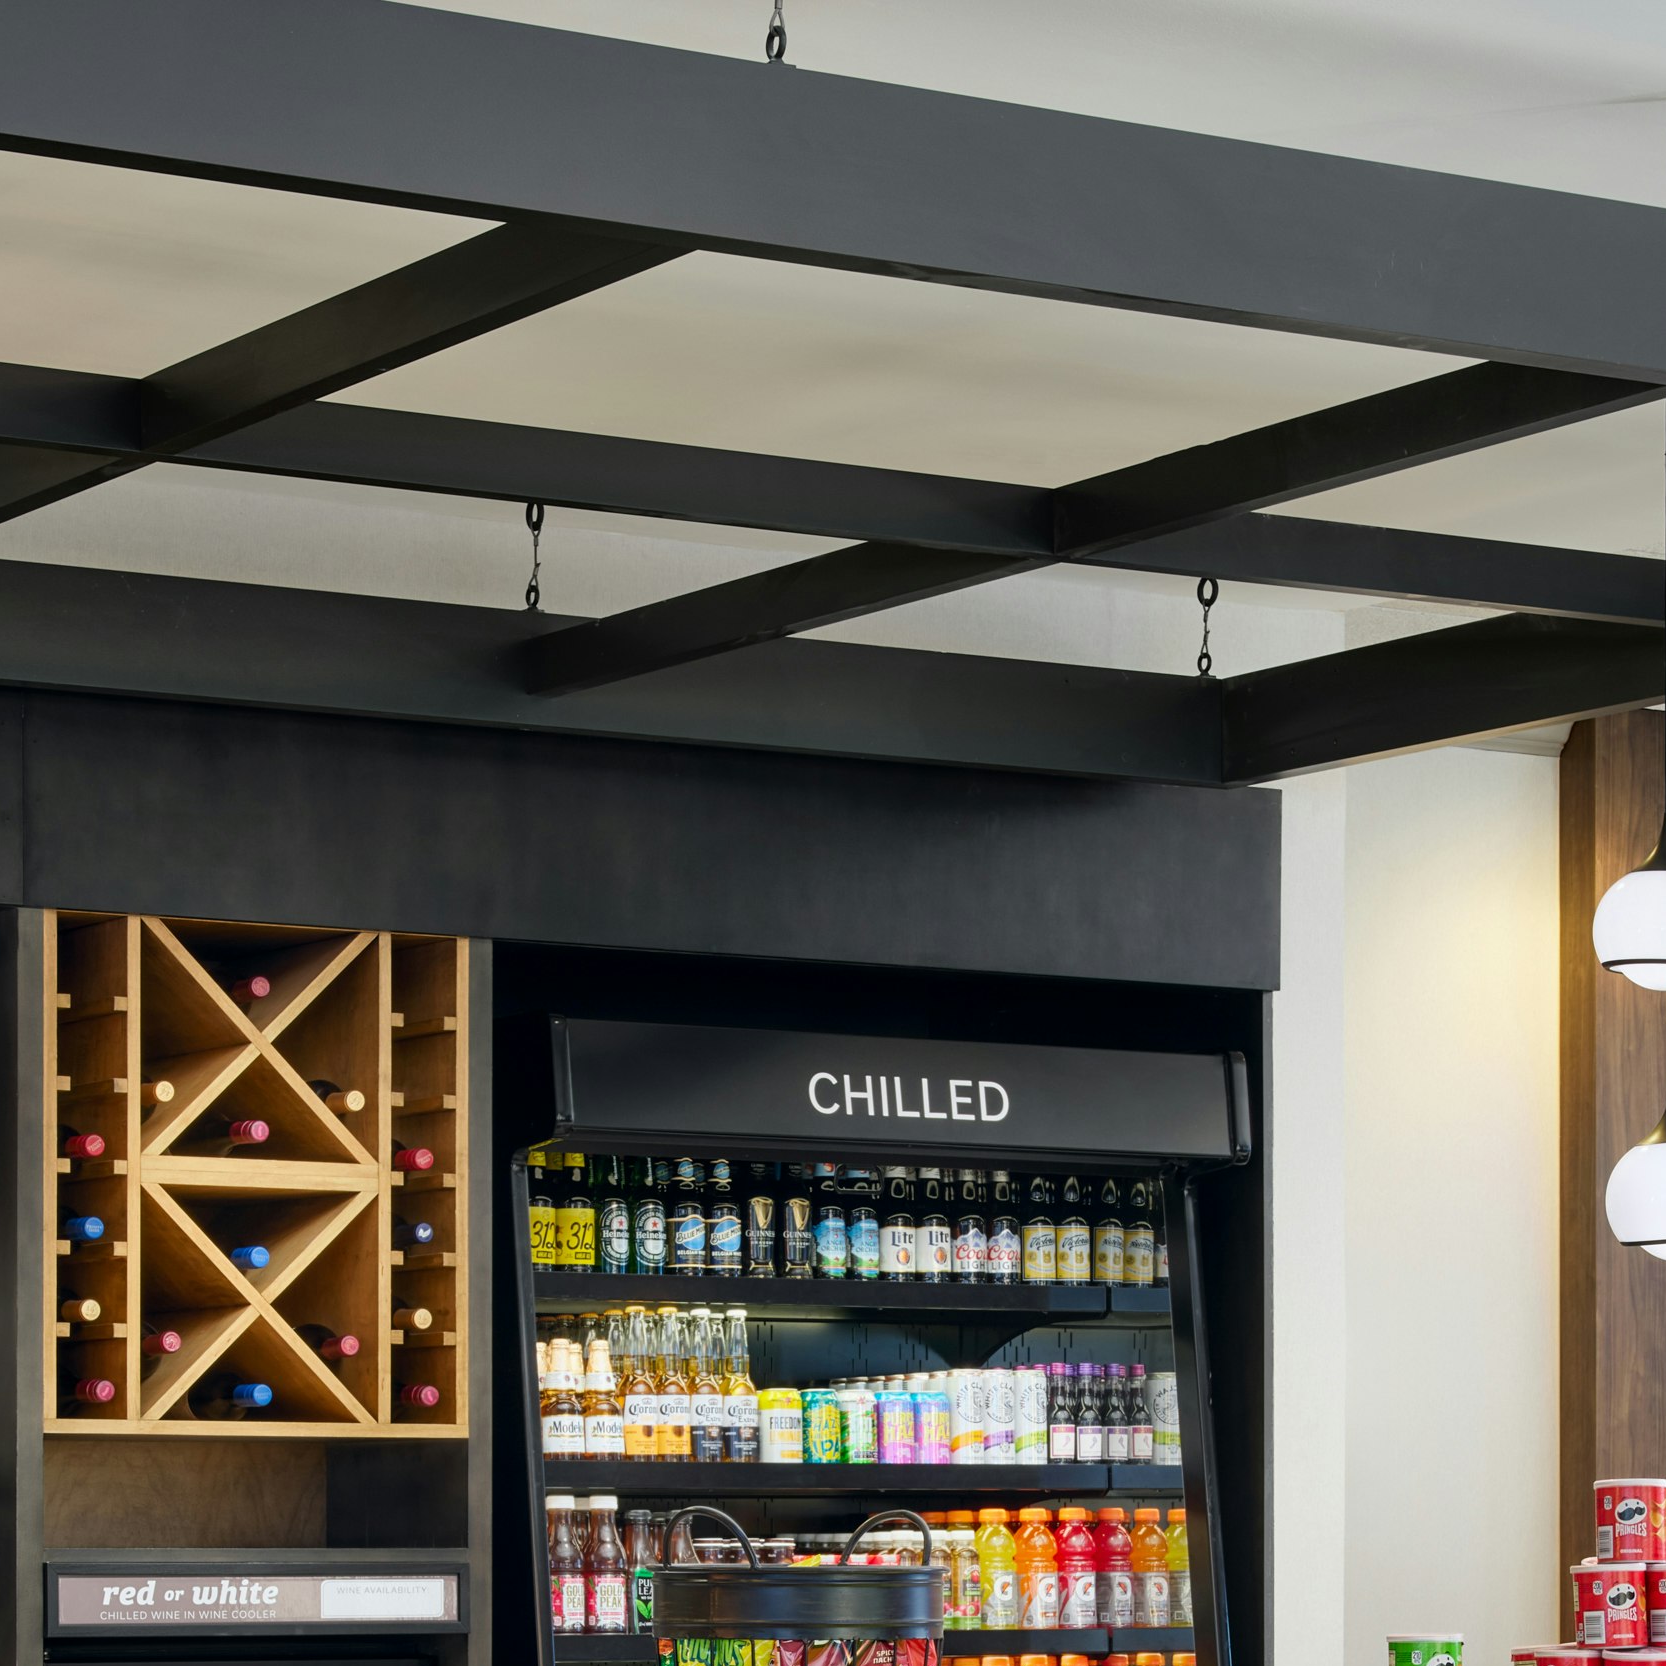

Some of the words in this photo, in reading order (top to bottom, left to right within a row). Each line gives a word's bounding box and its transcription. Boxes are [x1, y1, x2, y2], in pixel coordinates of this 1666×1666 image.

[808, 1072, 1009, 1121] CHILLED
[891, 1231, 913, 1247] Lite
[928, 1231, 949, 1246] Lite
[1616, 1523, 1647, 1537] PRINGLES
[103, 1580, 156, 1606] red
[164, 1588, 184, 1601] or
[192, 1579, 279, 1605] white
[336, 1586, 360, 1595] WINE
[364, 1586, 427, 1594] AVAILABILITY
[600, 1585, 623, 1596] GOLD
[600, 1598, 622, 1607] PEAK
[101, 1611, 147, 1620] CHILLED
[151, 1611, 181, 1620] WINE
[184, 1611, 195, 1619] IN
[199, 1610, 227, 1619] WINE
[232, 1609, 276, 1619] COOLER
[1607, 1607, 1637, 1622] PRINGLES
